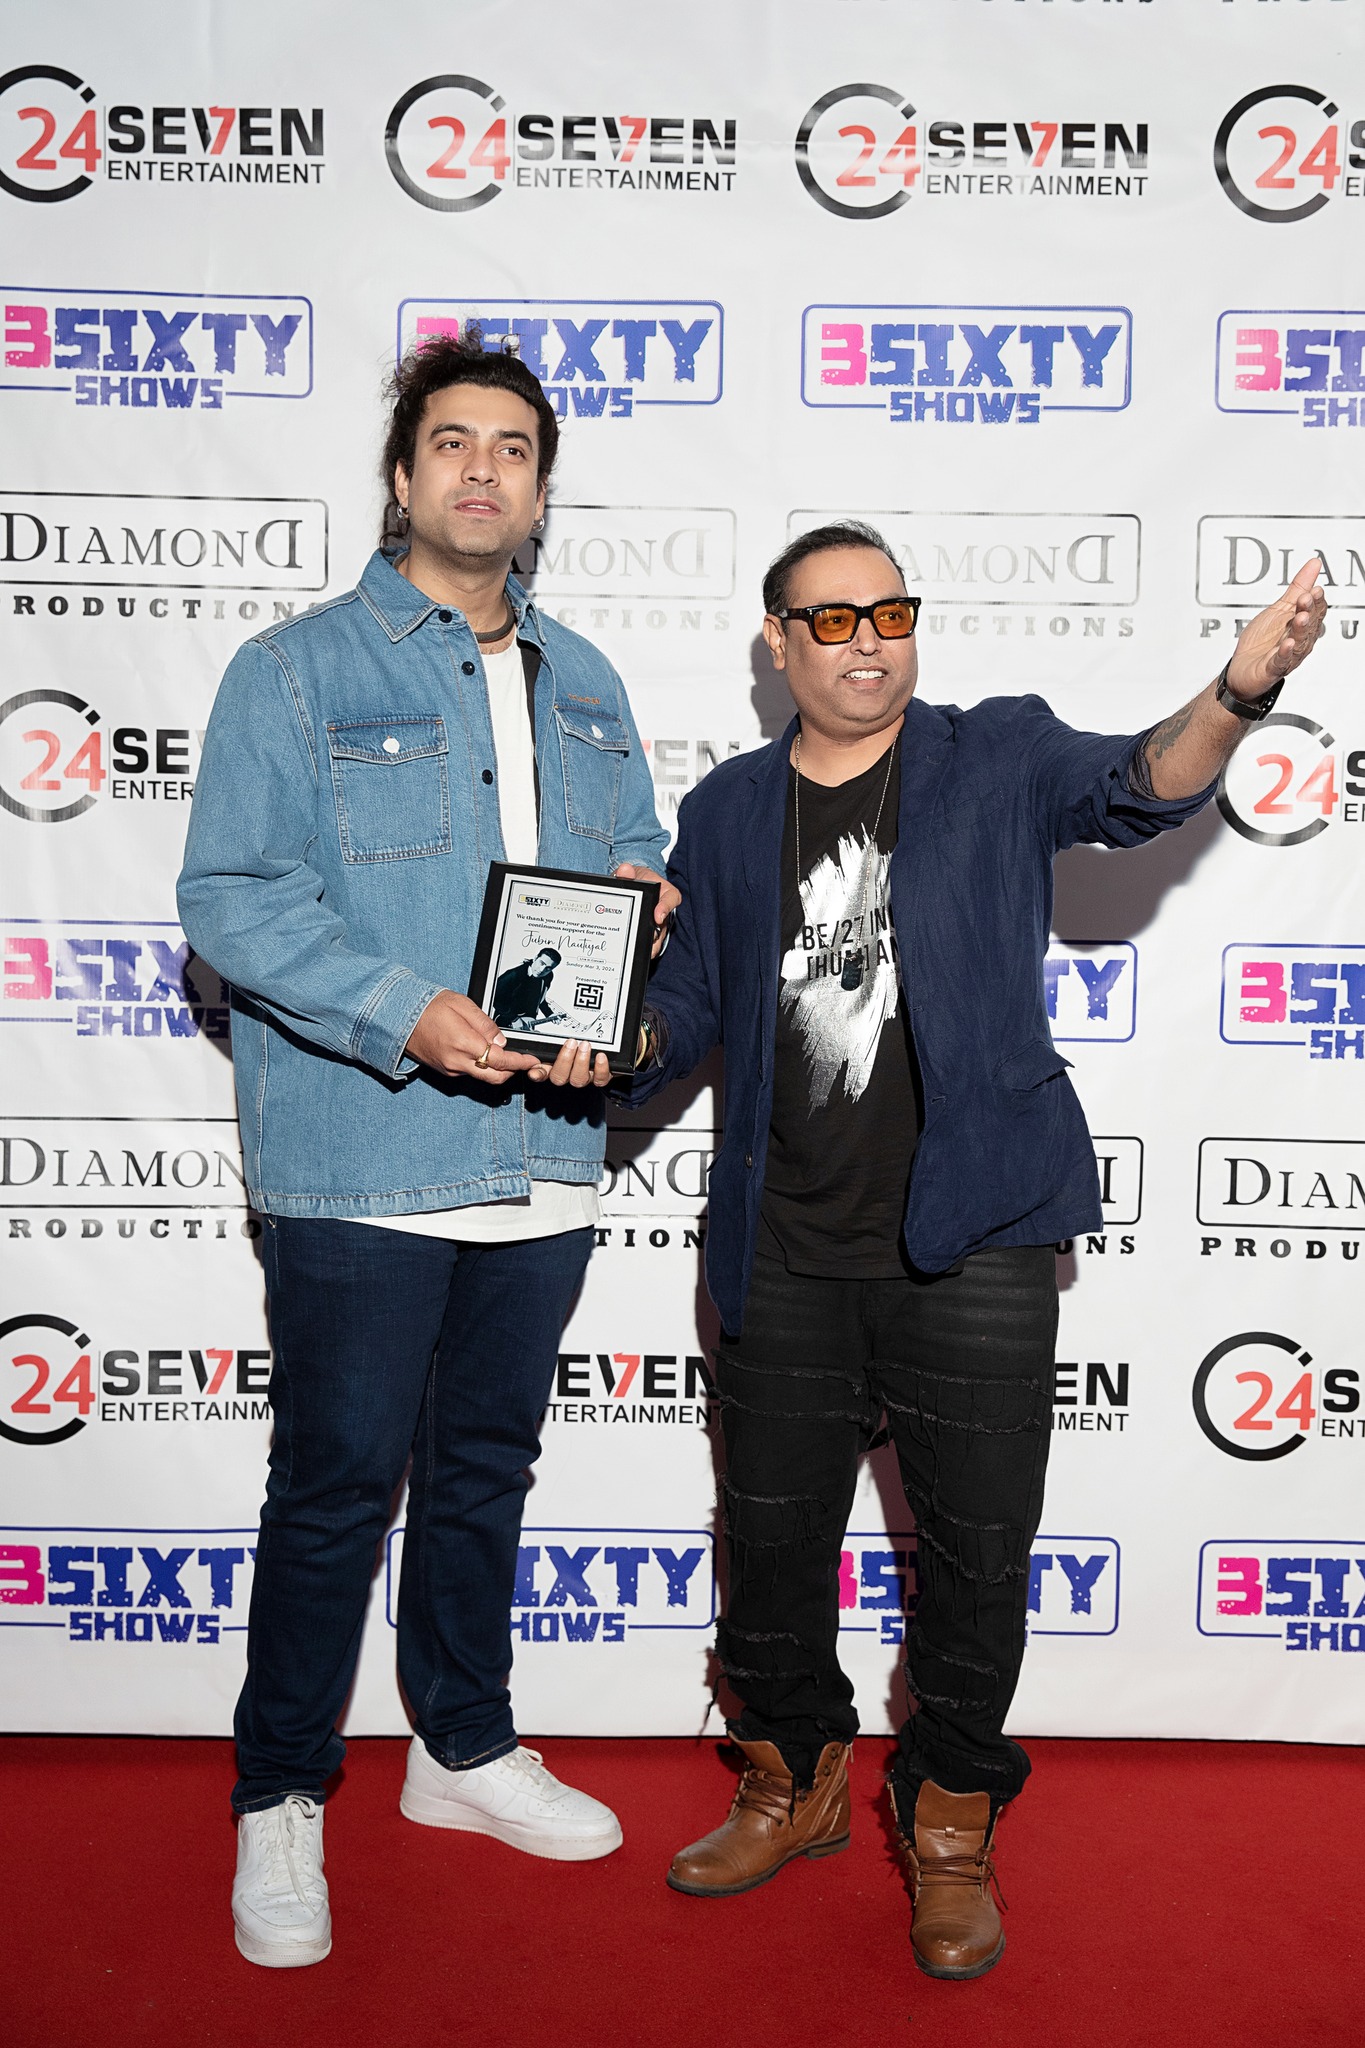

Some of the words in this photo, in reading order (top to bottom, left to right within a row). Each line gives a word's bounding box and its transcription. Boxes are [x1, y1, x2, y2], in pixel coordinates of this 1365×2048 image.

[16, 106, 101, 172] 24
[427, 115, 511, 180] 24
[836, 124, 921, 187] 24
[108, 160, 325, 184] ENTERTAINMENT
[1256, 125, 1341, 190] 24
[517, 167, 737, 192] ENTERTAINMENT
[927, 174, 1149, 196] ENTERTAINMENT
[4, 306, 302, 377] 3SIXTY
[821, 323, 1122, 389] 3SIXTY
[75, 375, 223, 409] SHOWS
[542, 386, 634, 418] OWS
[889, 391, 1041, 424] SHOWS
[510, 528, 711, 578] MOND
[900, 535, 1115, 585] AMOND
[13, 595, 323, 621] RODUCTION
[556, 607, 731, 632] CTIONS
[928, 615, 1134, 638] UCTIONS
[20, 729, 106, 792] 24
[1253, 753, 1338, 815] 24
[528, 922, 561, 930] continuous
[562, 926, 585, 935] support
[580, 922, 607, 931] generous
[4, 937, 231, 1004] 3SIX
[575, 975, 601, 984] Presented
[76, 1006, 231, 1039] SHOWS
[0, 1136, 247, 1189] DIAMON
[8, 1218, 263, 1240] RODUCTIO
[11, 1354, 96, 1415] 24
[102, 1348, 271, 1396] SEVE
[557, 1352, 716, 1399] EVEN
[101, 1401, 270, 1422] ENTERTAINM
[1233, 1371, 1316, 1431] 24
[0, 1544, 259, 1609] 3SIXT
[512, 1545, 706, 1608] IXTY
[69, 1611, 220, 1644] SHOWS
[510, 1612, 625, 1643] HOWS
[1285, 1621, 1365, 1653] SHO
